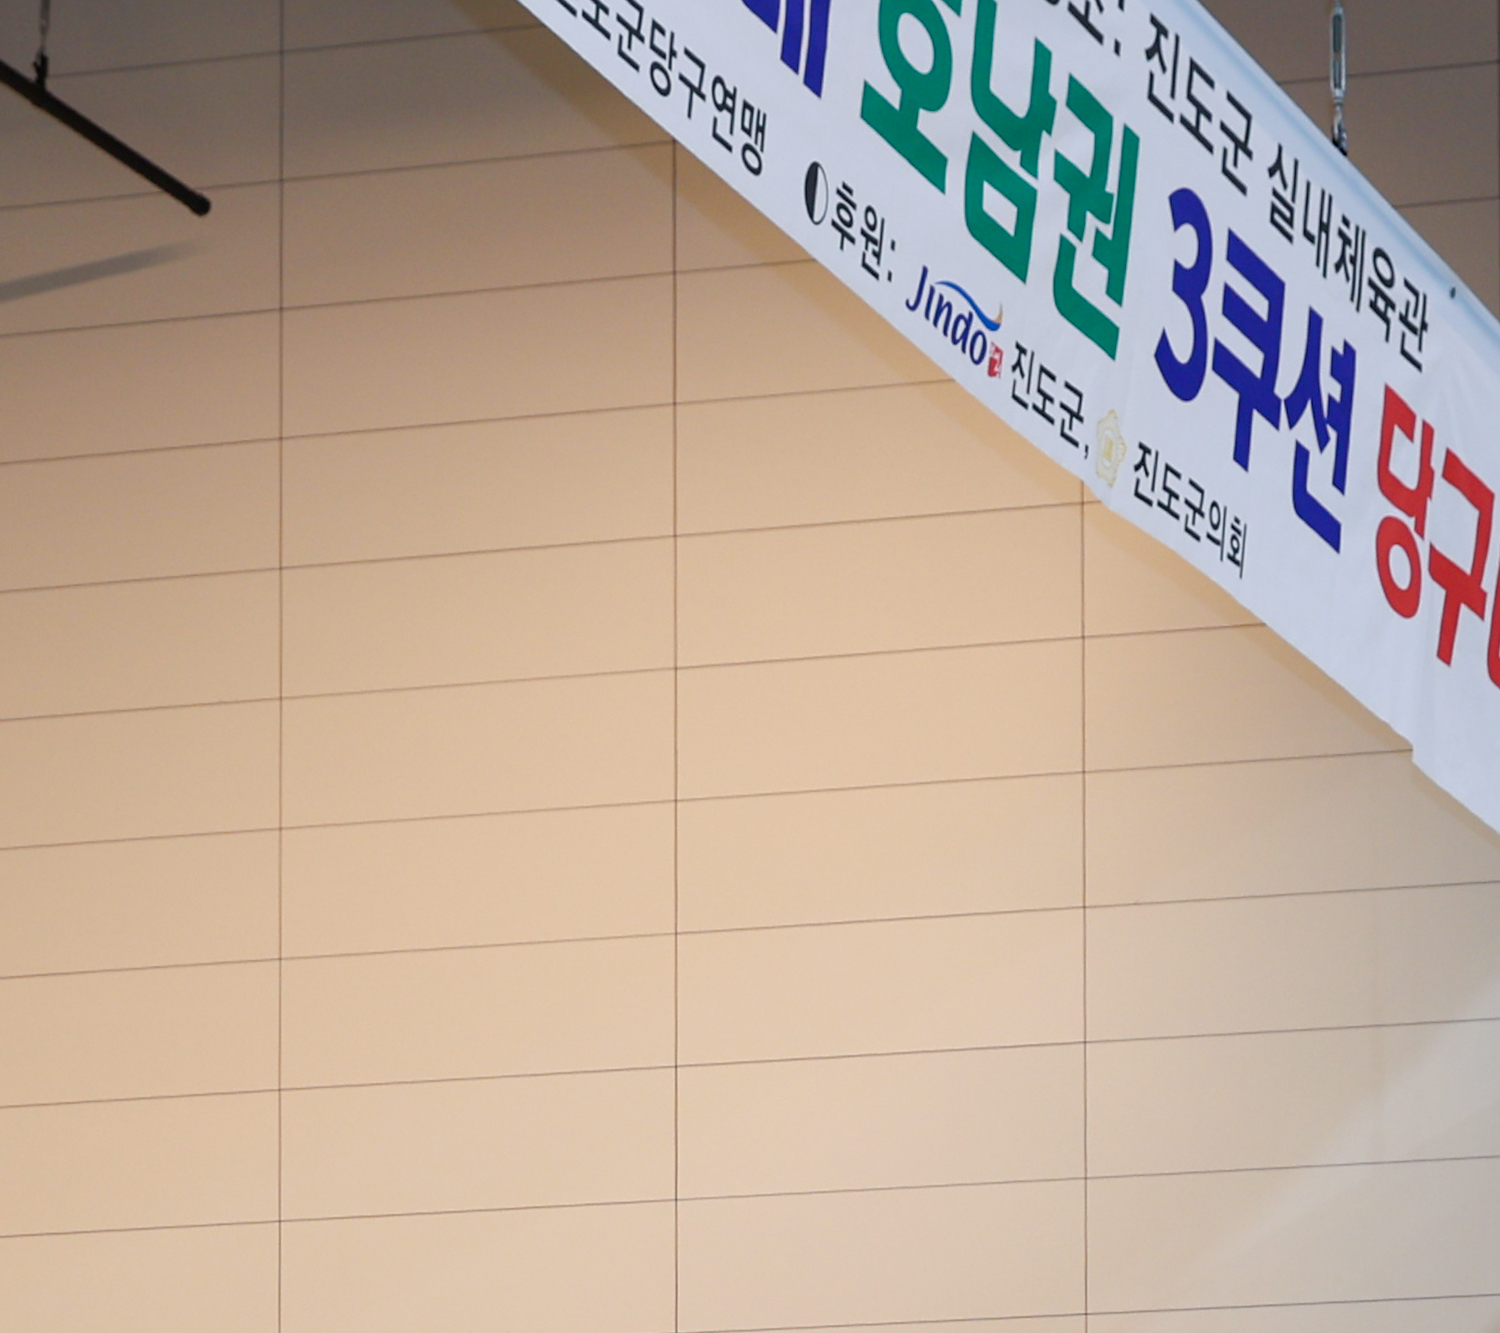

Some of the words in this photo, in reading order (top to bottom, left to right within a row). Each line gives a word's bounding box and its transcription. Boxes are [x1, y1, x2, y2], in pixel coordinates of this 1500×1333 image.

[830, 181, 897, 283] 후원:
[1145, 14, 1254, 196] 진도군
[1267, 143, 1429, 374] 실내체육관
[860, 0, 1140, 361] 호남권
[1154, 187, 1356, 555] 3쿠션
[905, 265, 988, 366] Jindo
[1010, 341, 1090, 460] 진도군,
[1133, 441, 1248, 579] 진도군의회
